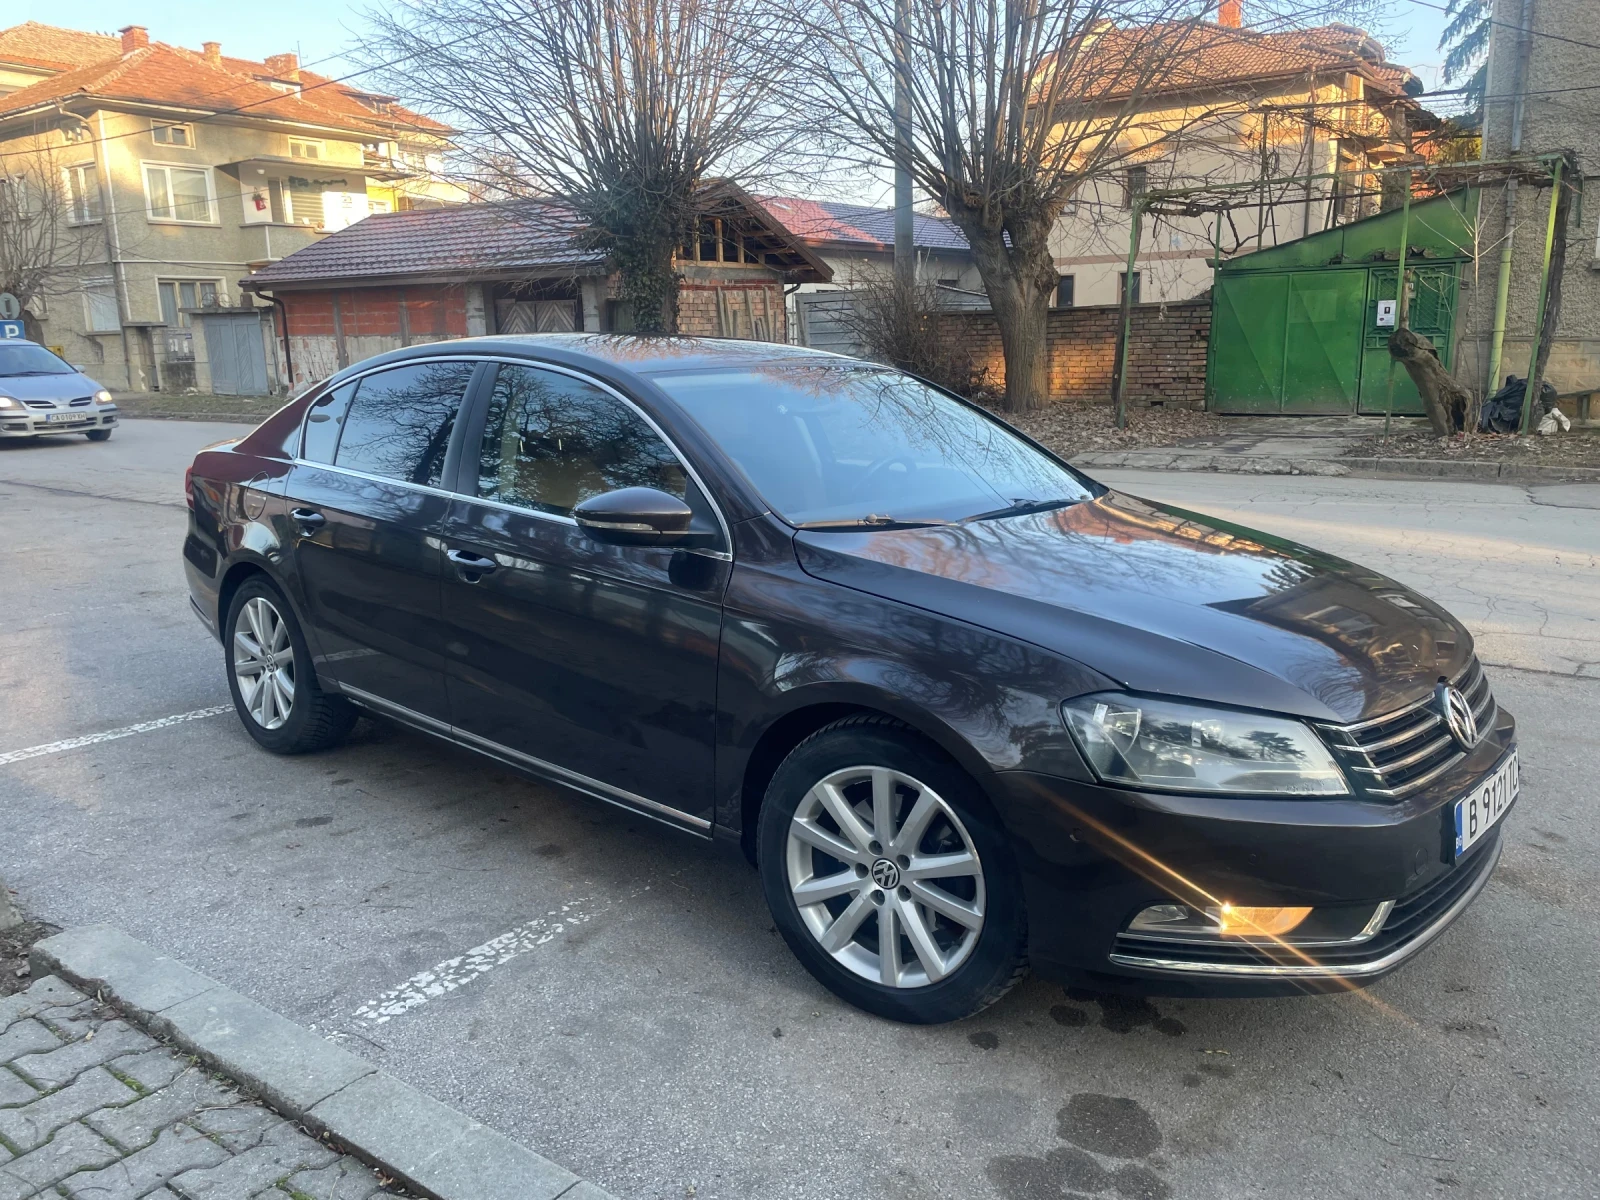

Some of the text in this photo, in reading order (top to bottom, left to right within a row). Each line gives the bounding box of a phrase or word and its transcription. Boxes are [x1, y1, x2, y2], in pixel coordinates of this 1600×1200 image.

[4, 324, 20, 339] P
[1469, 798, 1478, 839] B
[1482, 767, 1507, 825] 9121
[872, 858, 899, 889] VW
